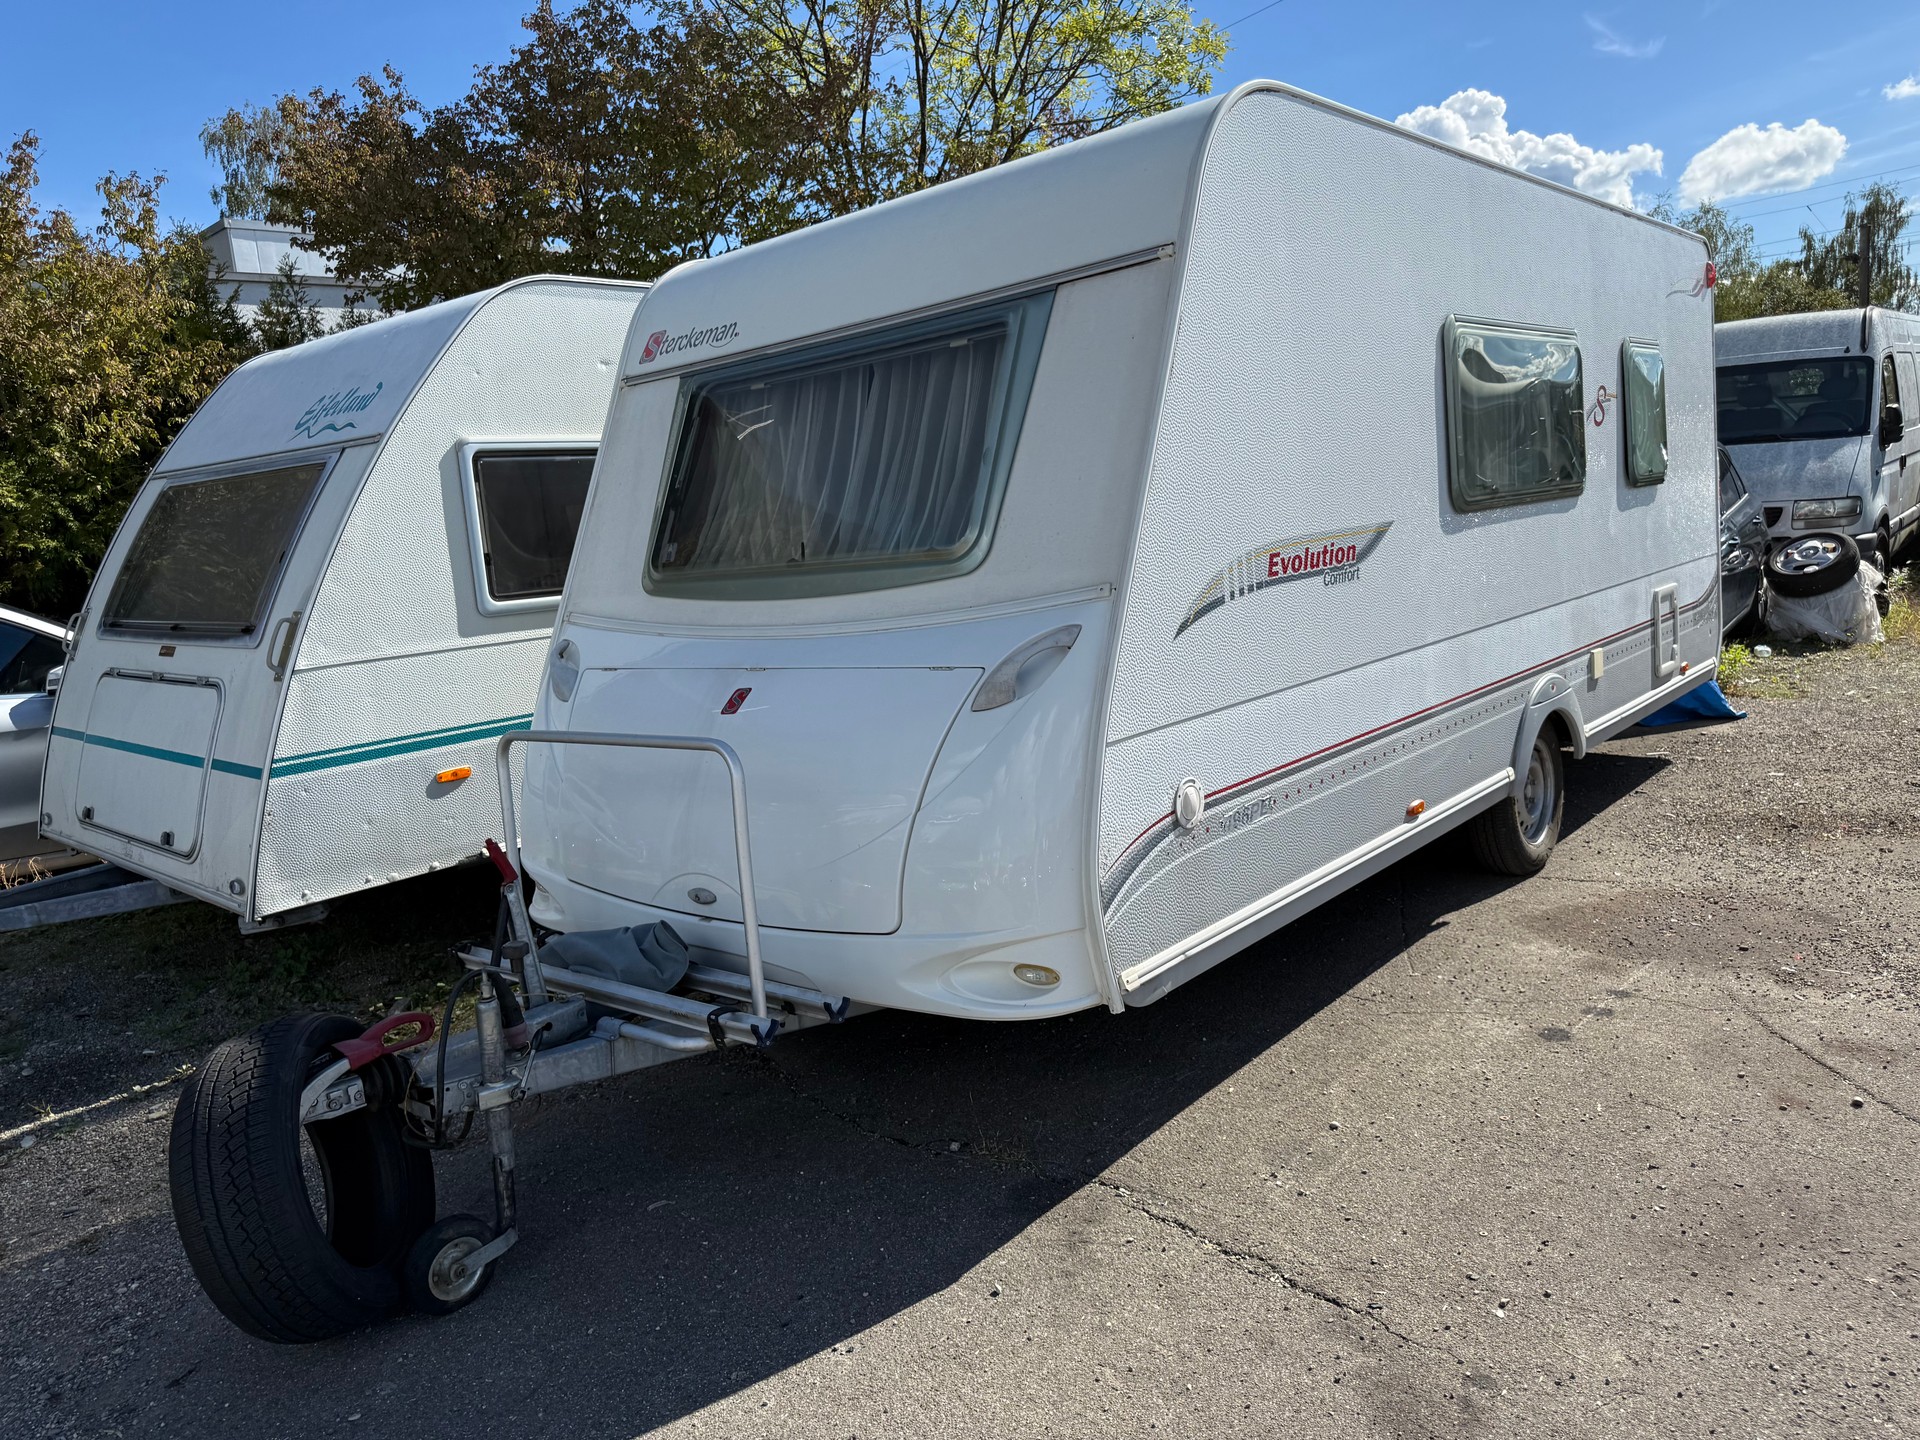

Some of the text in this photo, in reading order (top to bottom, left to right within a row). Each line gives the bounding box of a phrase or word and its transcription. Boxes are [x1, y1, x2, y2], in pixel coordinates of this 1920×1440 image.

[639, 320, 738, 365] Sterckeman
[1267, 542, 1357, 578] Evolution
[1323, 566, 1360, 587] Comfort
